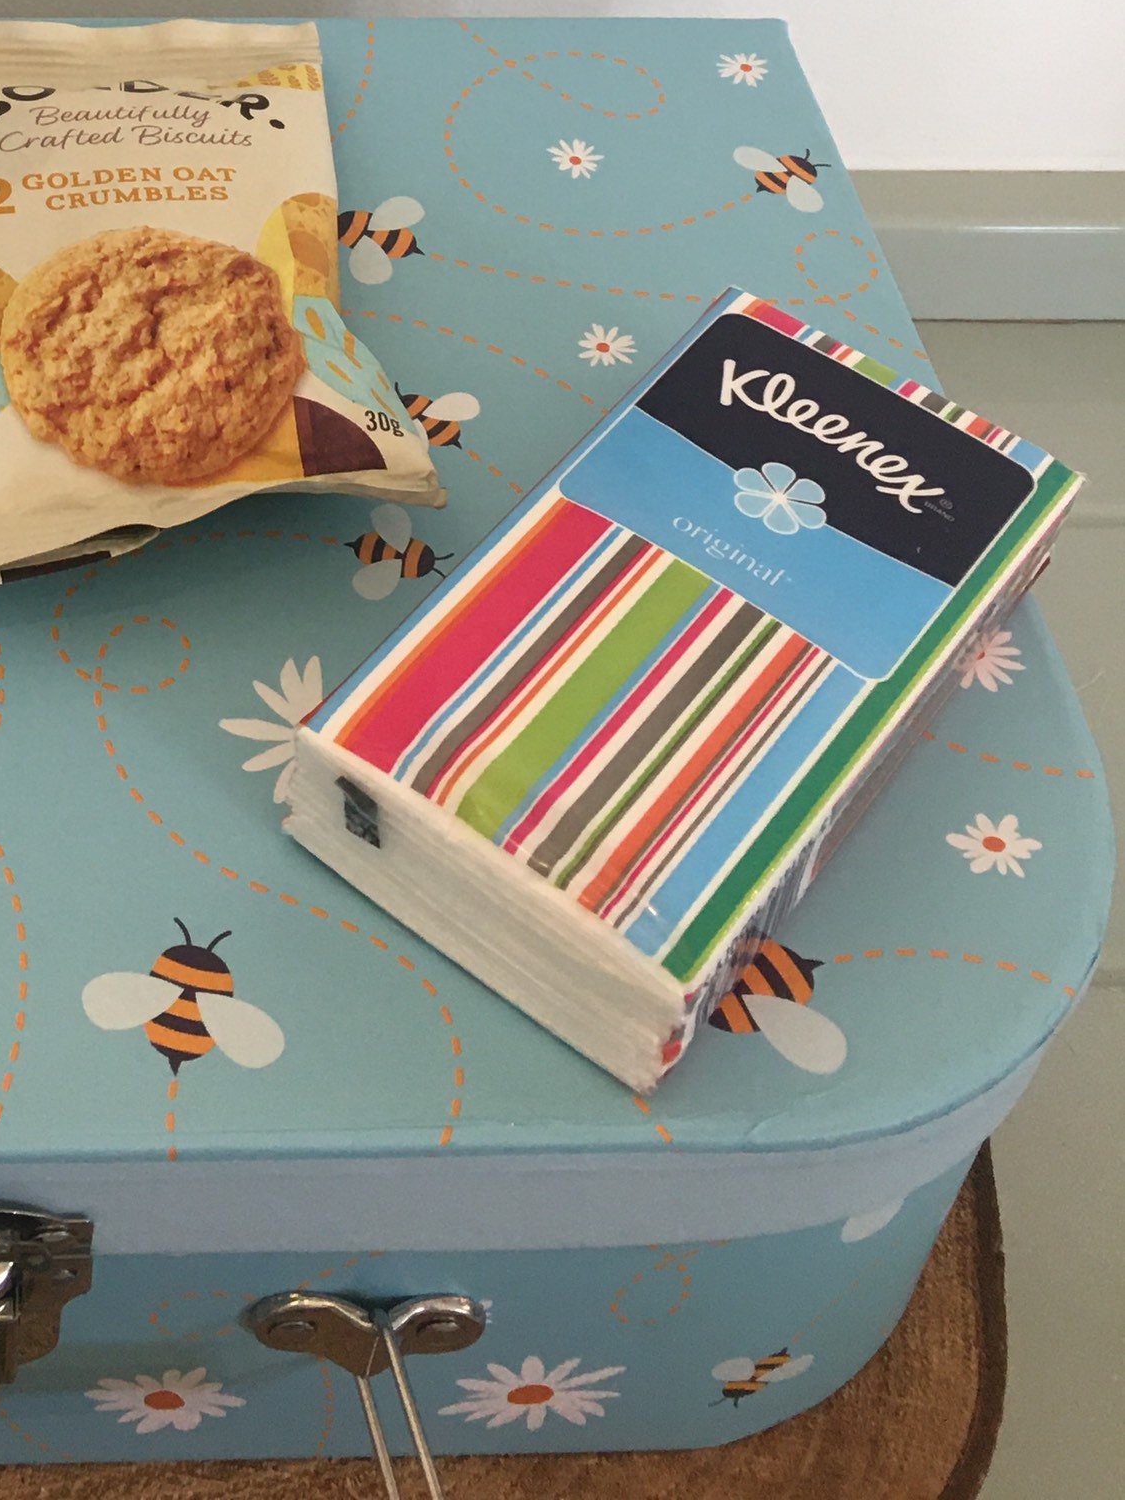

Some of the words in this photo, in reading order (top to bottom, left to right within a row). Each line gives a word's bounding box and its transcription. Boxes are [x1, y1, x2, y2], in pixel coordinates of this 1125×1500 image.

[29, 104, 211, 128] Beautifully
[131, 125, 253, 147] Biscuits
[21, 167, 162, 190] GOLDEN
[172, 166, 238, 182] OAT
[44, 185, 230, 211] CRUMBLES
[364, 410, 404, 437] 30g
[719, 358, 946, 514] Kleenex
[673, 516, 784, 587] original
